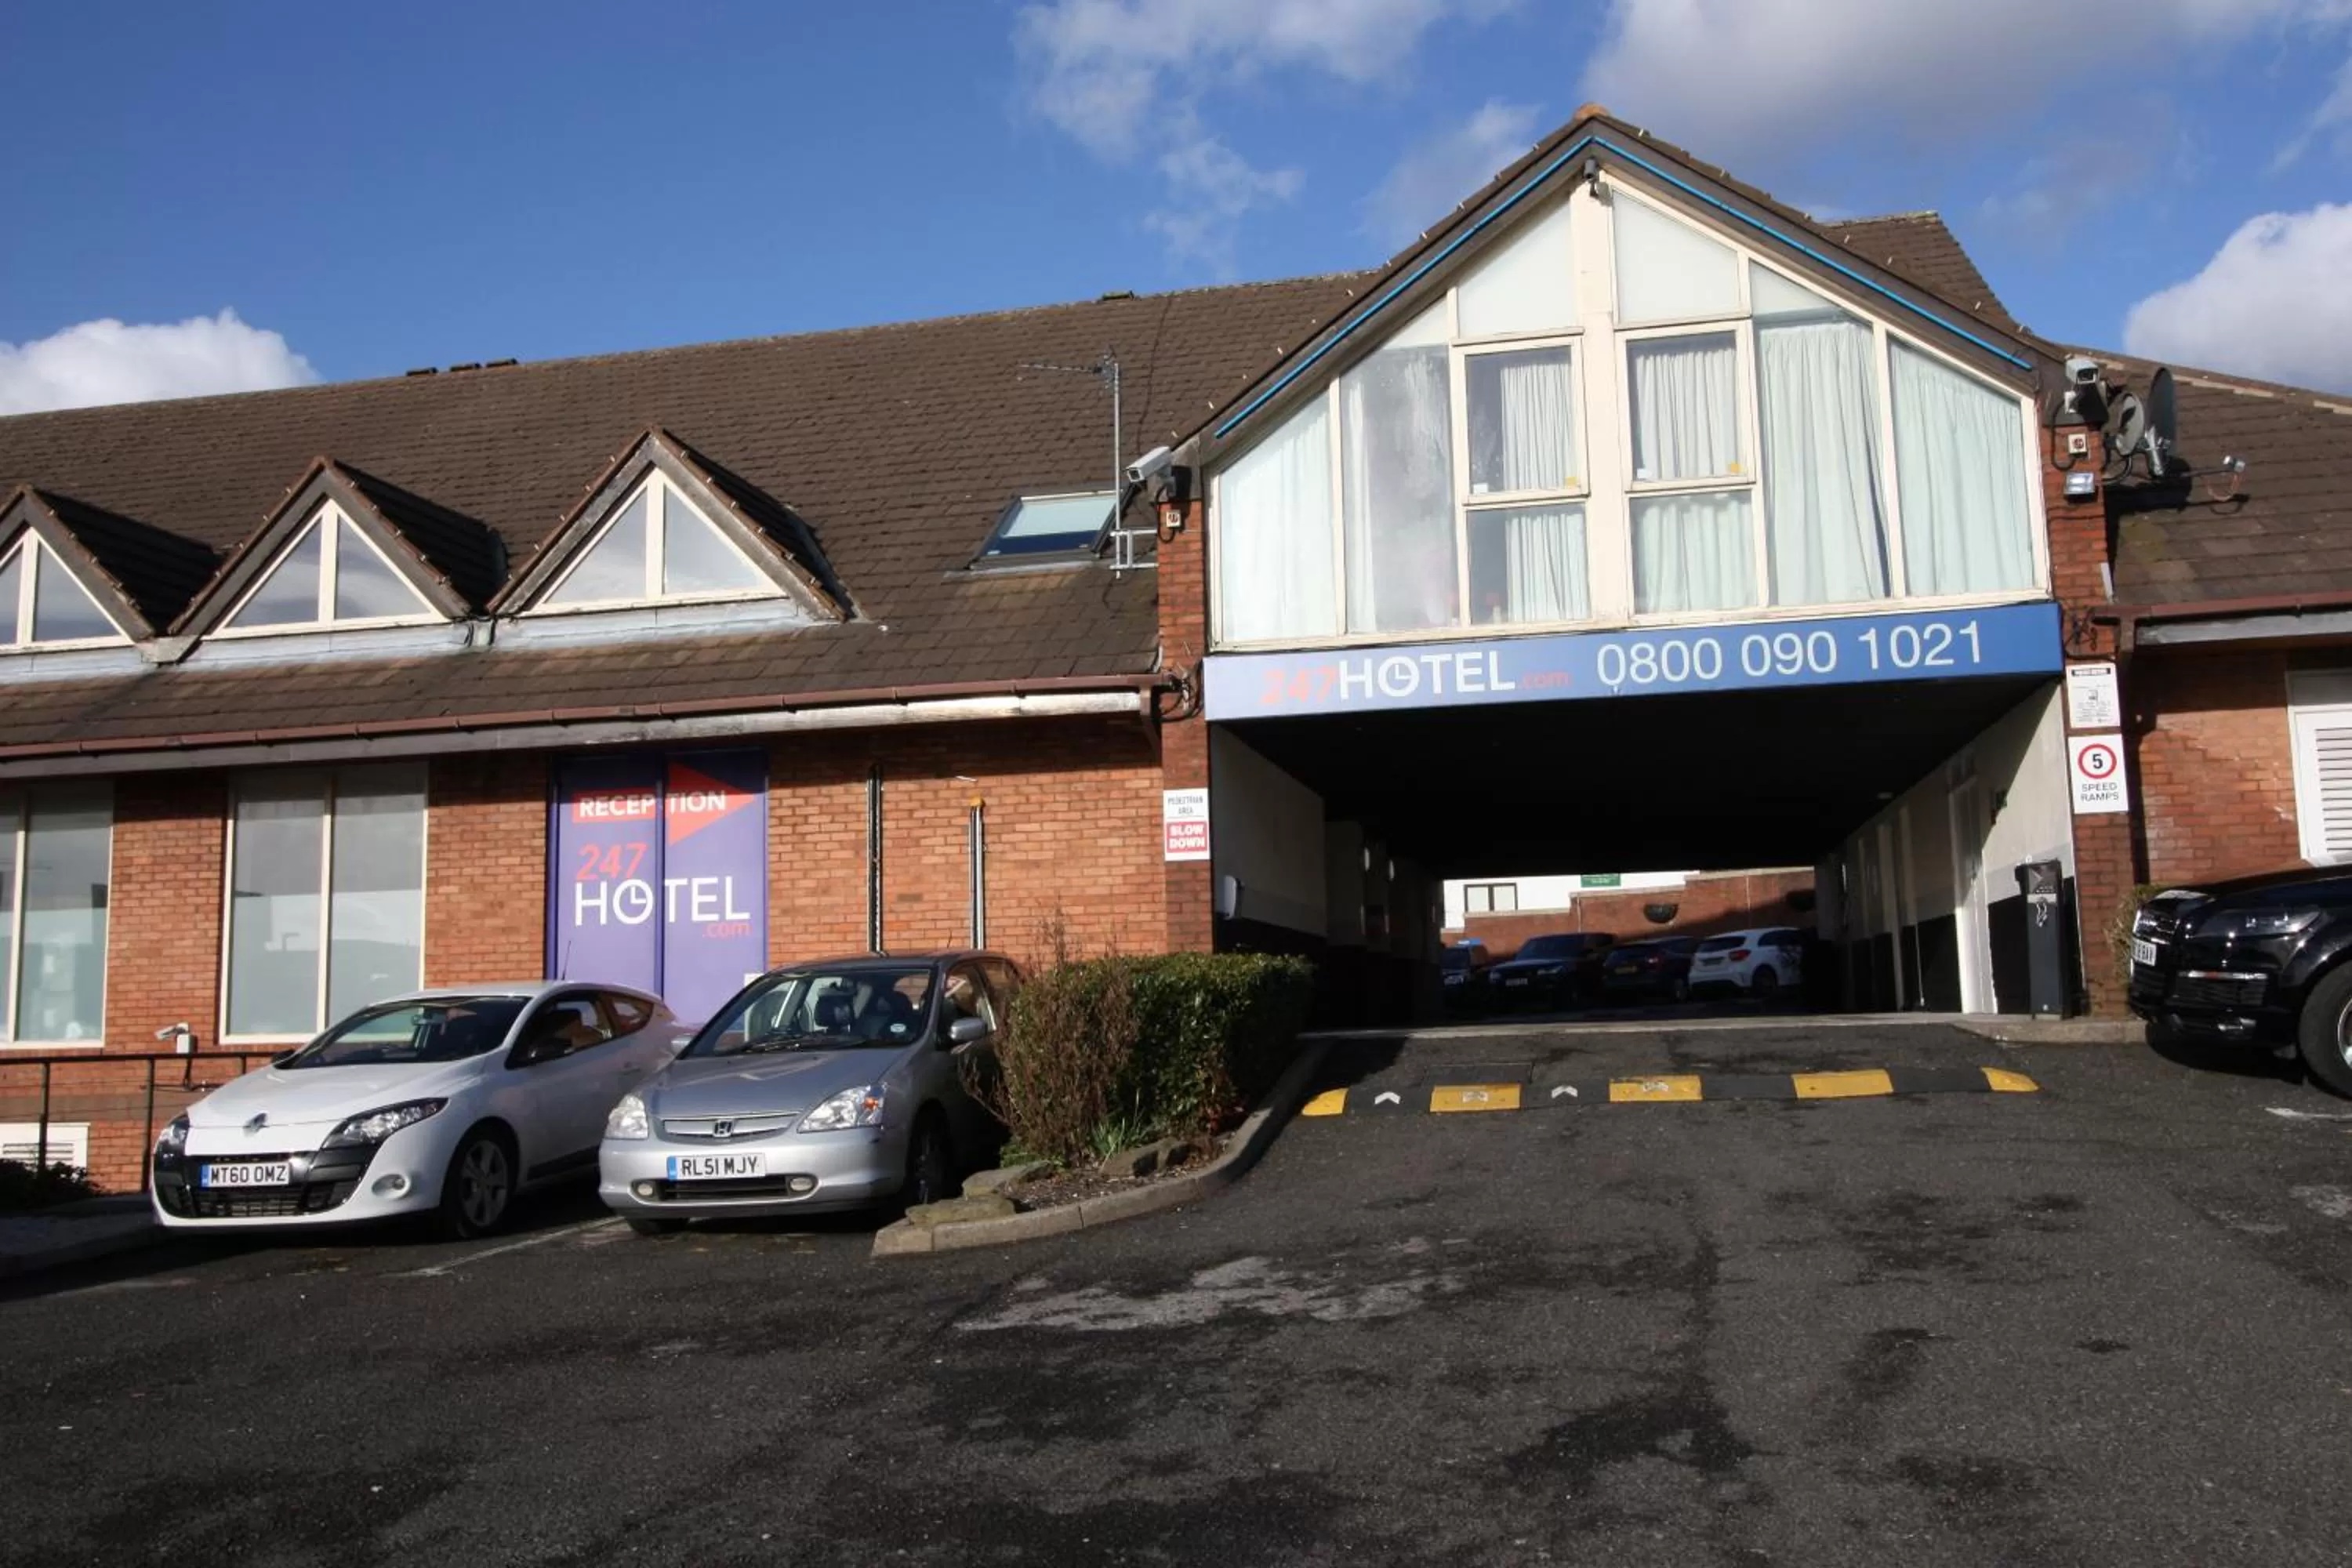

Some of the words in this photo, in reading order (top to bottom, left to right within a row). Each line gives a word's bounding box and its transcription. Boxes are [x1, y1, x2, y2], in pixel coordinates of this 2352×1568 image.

[1597, 637, 1722, 685] 0800
[1741, 630, 1838, 677] 090
[1857, 620, 1980, 670] 1021
[2092, 753, 2103, 770] 5
[2082, 781, 2118, 792] SPEED
[2081, 791, 2119, 802] RAMPS
[1169, 824, 1204, 837] SLOW
[1168, 837, 1206, 849] DOWN
[576, 841, 648, 880] 247
[574, 876, 751, 927] HOTEL
[681, 1157, 719, 1176] RL51
[724, 1156, 757, 1174] MJY
[210, 1166, 249, 1184] MT60
